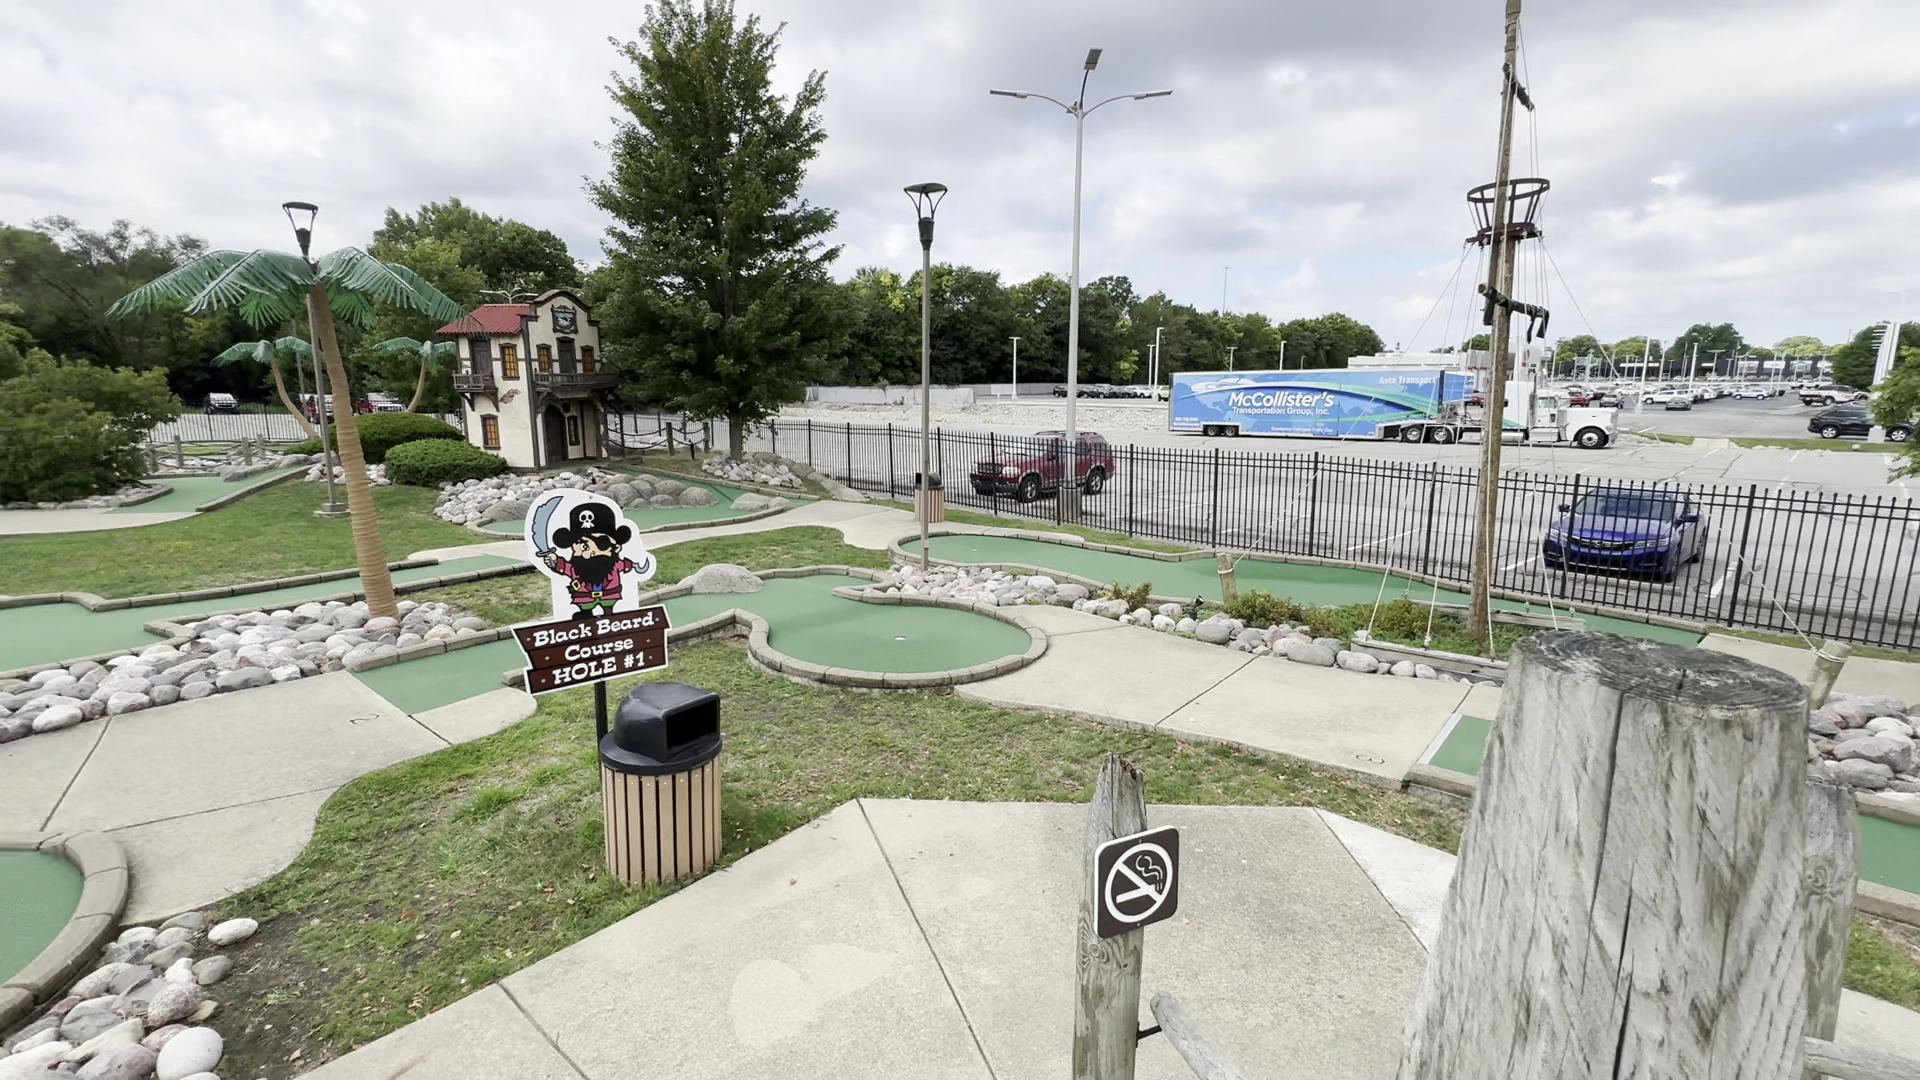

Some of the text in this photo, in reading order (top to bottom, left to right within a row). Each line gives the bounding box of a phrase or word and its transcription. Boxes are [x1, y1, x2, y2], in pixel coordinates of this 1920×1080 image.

[1379, 375, 1437, 386] Auto Transport
[1229, 391, 1335, 407] McCollister's
[1232, 407, 1330, 416] Transportation Group, Inc.
[533, 612, 655, 648] Black Beard
[564, 638, 634, 661] Course
[552, 652, 646, 685] HOLE #1
